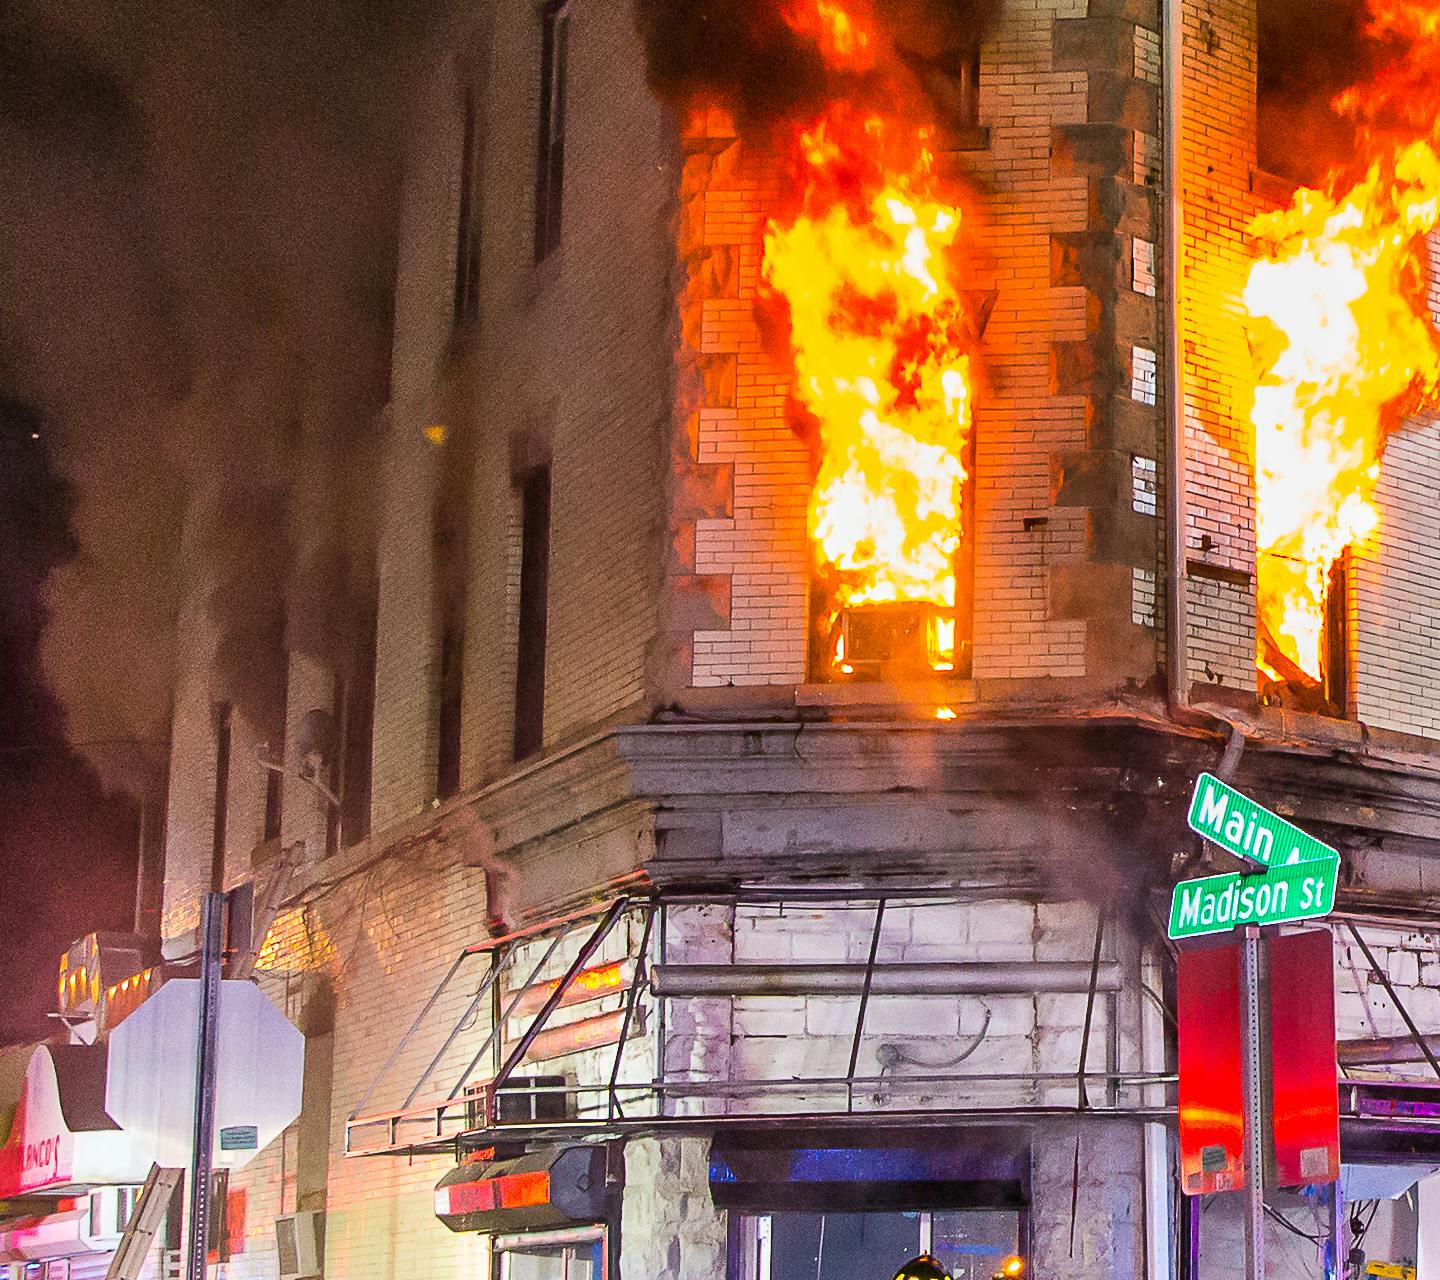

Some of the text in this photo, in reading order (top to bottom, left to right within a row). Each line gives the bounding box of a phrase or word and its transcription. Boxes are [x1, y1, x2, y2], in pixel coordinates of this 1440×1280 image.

[1198, 783, 1274, 862] Main
[1178, 876, 1325, 929] Madison St
